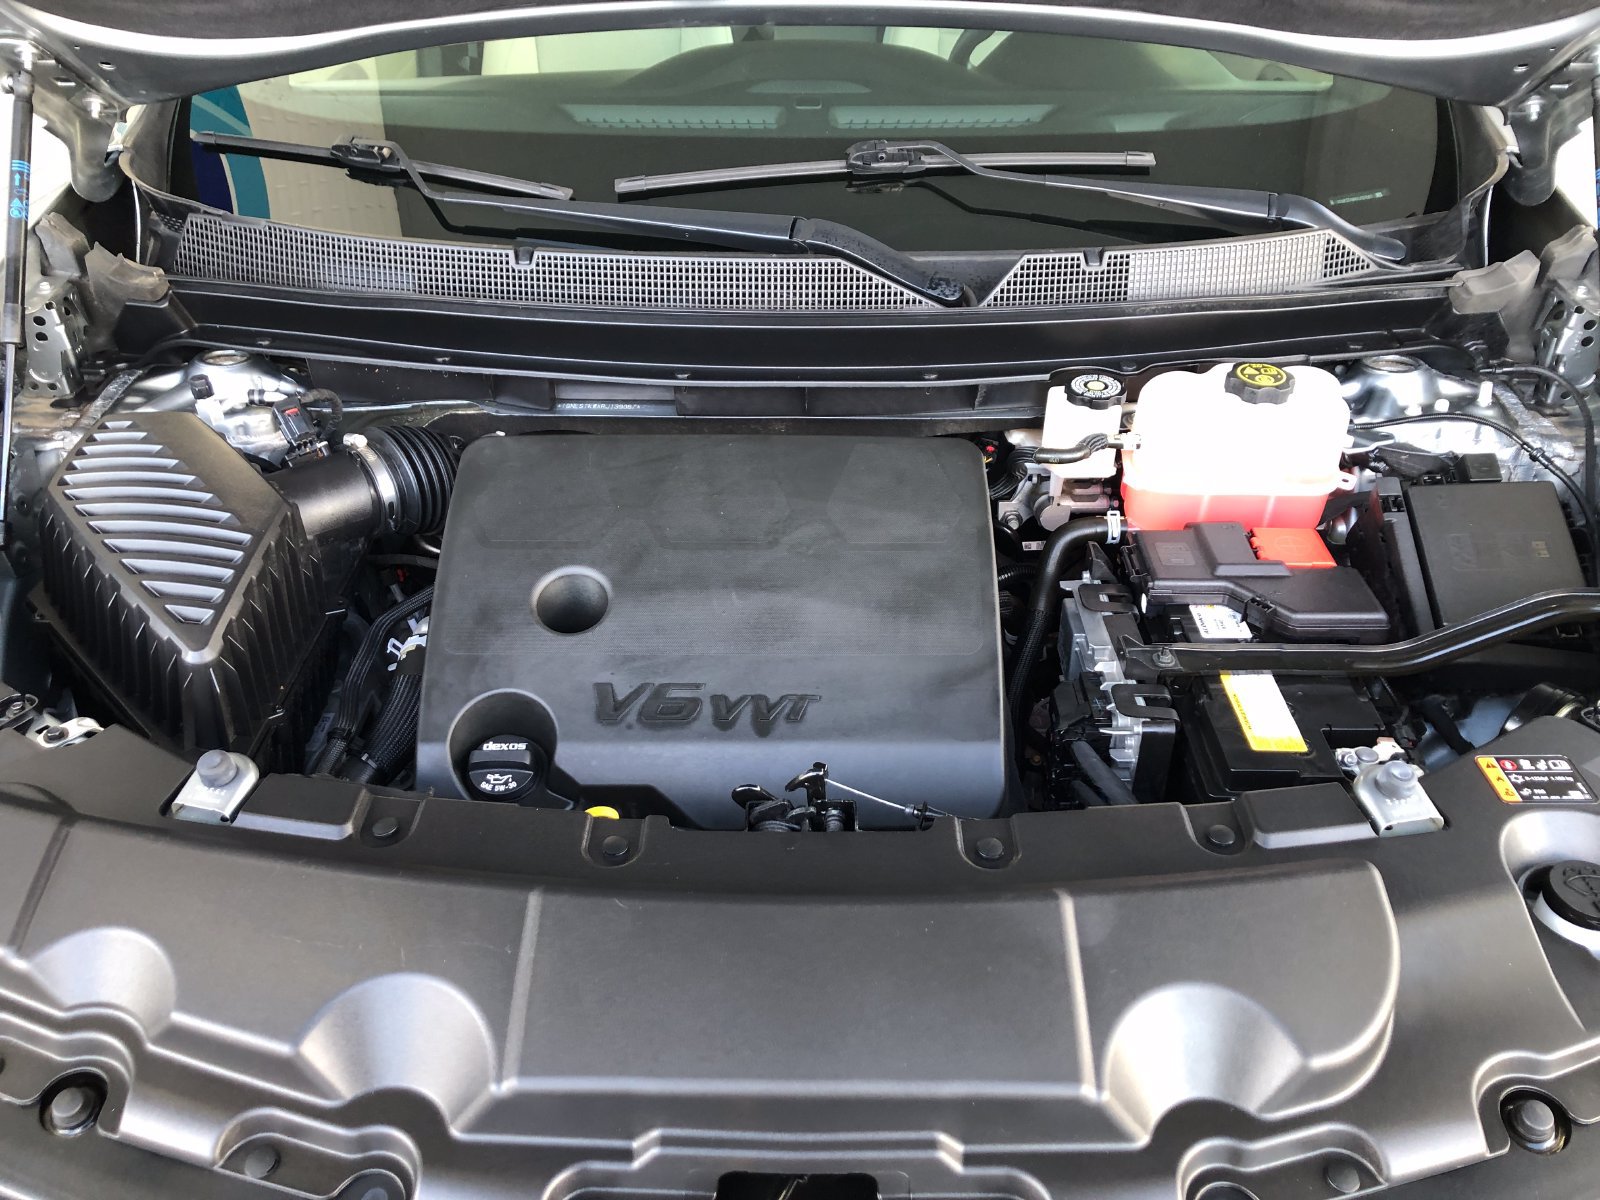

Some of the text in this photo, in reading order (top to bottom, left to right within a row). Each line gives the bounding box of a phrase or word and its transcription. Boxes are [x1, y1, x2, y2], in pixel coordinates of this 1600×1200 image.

[593, 682, 822, 735] V6 VVT
[482, 741, 528, 751] dexos
[480, 781, 518, 792] SAE 5W-30
